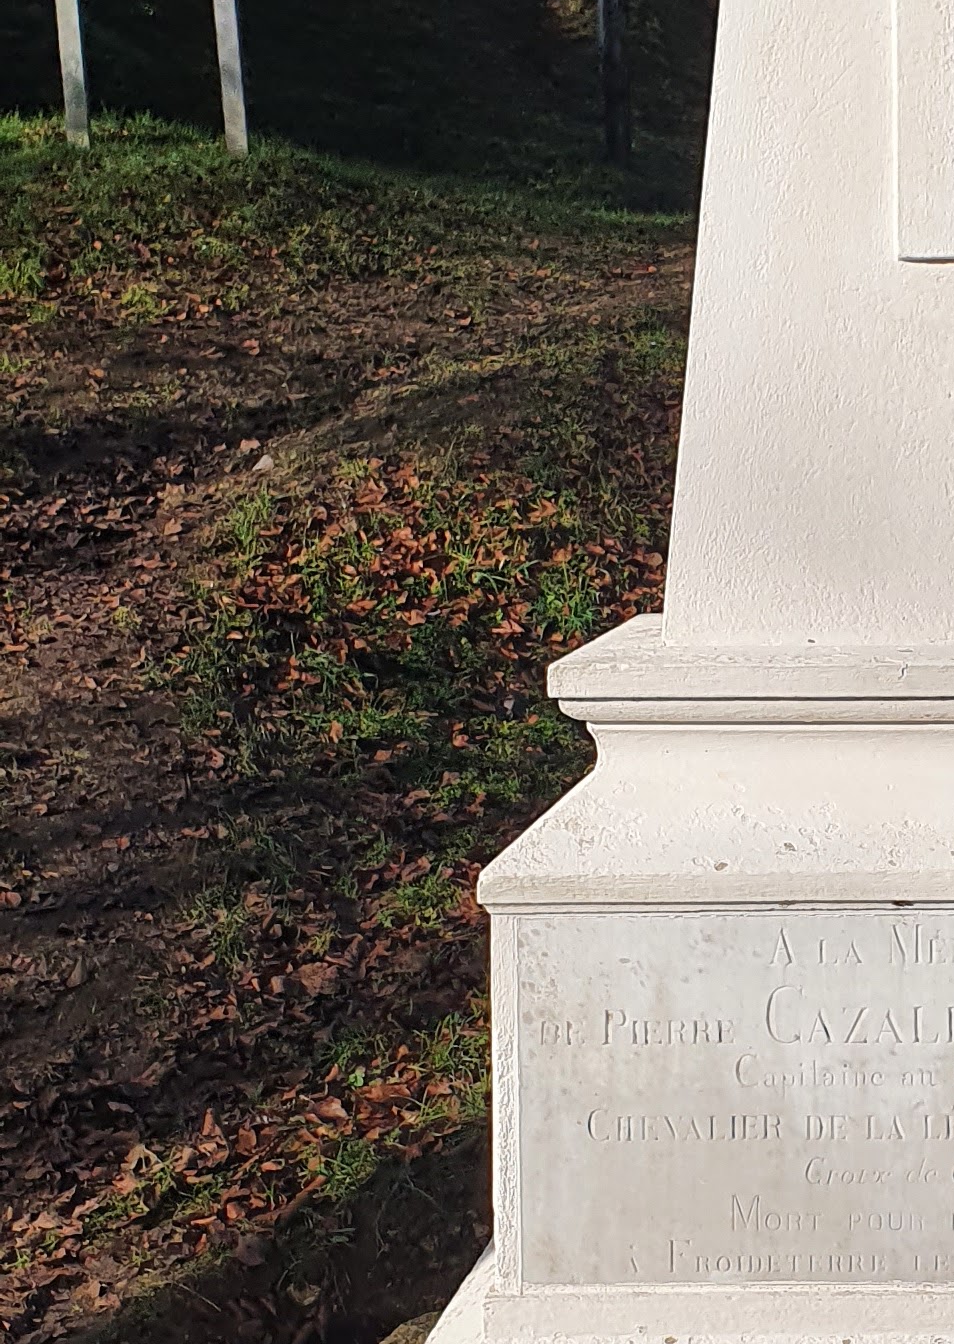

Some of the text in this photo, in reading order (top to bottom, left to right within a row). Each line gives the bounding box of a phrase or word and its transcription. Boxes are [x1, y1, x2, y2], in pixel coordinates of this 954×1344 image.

[818, 938, 863, 965] LA
[539, 1019, 587, 1047] DE
[601, 1008, 737, 1047] PIERRE
[734, 1052, 886, 1093] Capitaine
[900, 1066, 939, 1088] au
[587, 1108, 784, 1143] CHEVALIER
[804, 1114, 849, 1142] DE
[865, 1114, 907, 1142] LA
[804, 1156, 894, 1185] Croix
[905, 1157, 938, 1185] de
[731, 1193, 825, 1233] MORT
[848, 1211, 925, 1233] POUR
[669, 1238, 887, 1274] FROIDETERRE
[913, 1255, 950, 1273] LE
